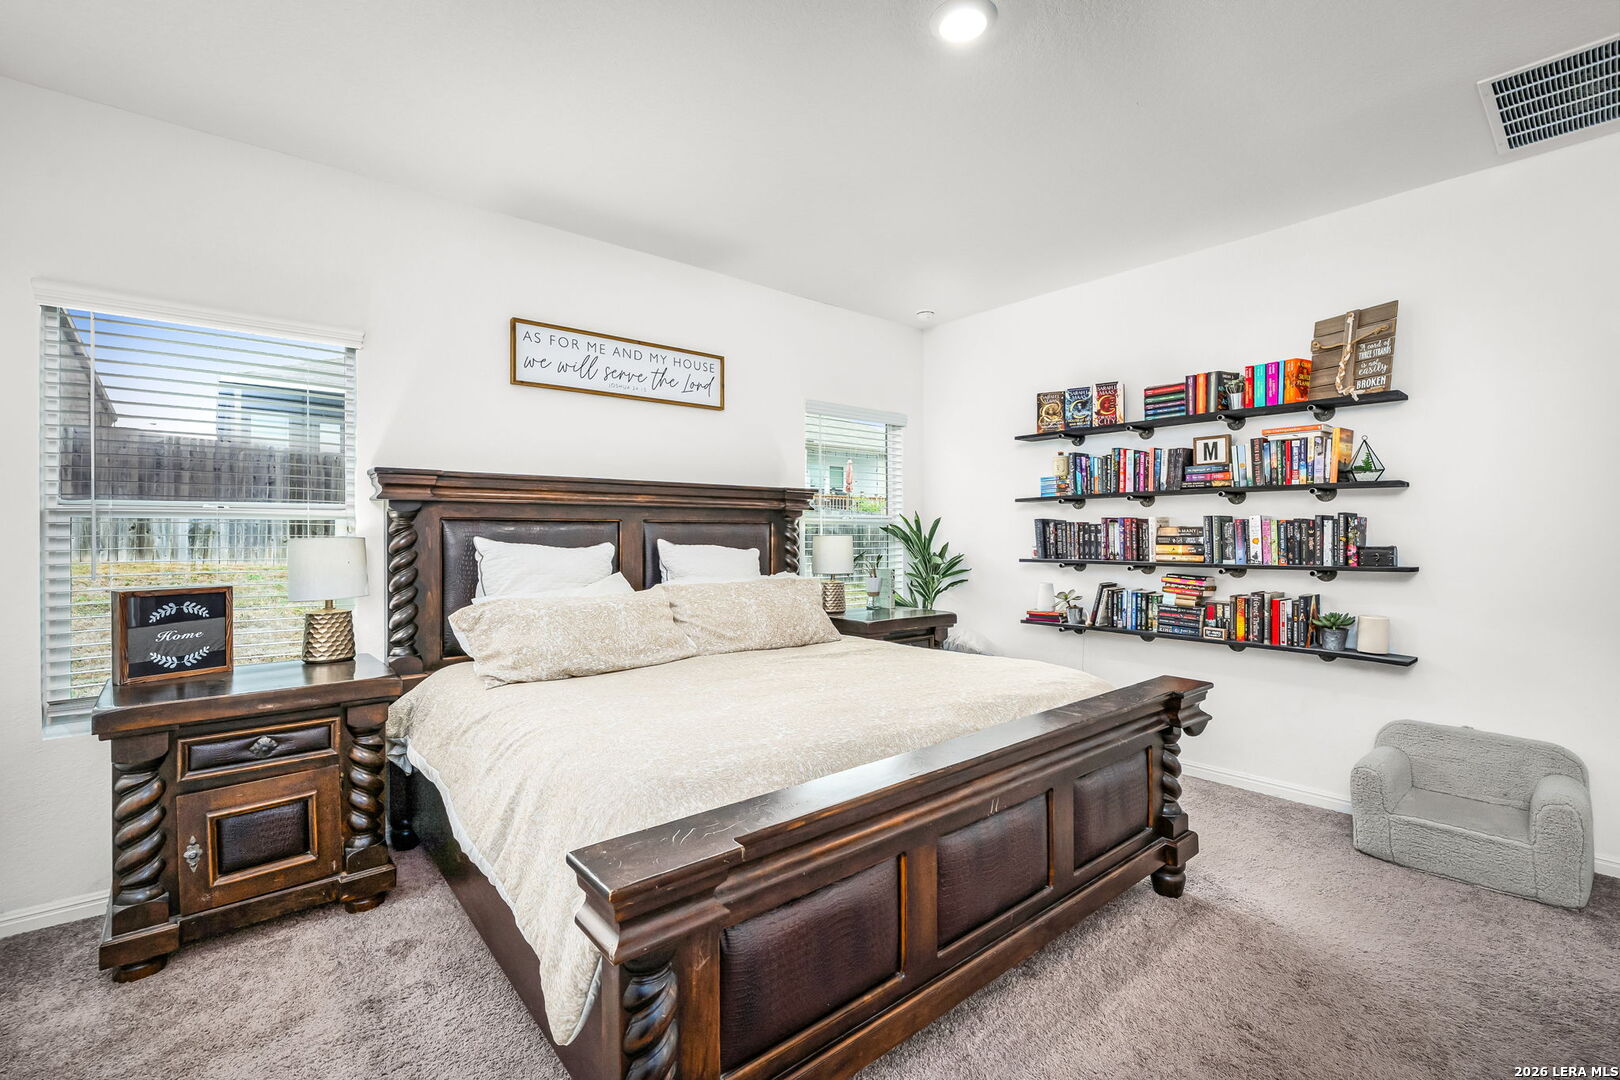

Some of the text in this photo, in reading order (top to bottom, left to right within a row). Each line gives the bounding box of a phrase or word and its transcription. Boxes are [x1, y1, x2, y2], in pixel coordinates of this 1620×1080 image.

[522, 331, 715, 373] AS FOR ME AND MY HOUSE
[524, 355, 714, 398] we will serve the Lord
[1358, 362, 1388, 376] easily
[1356, 376, 1386, 390] BROKEN
[1204, 442, 1218, 461] M
[155, 630, 204, 643] Home
